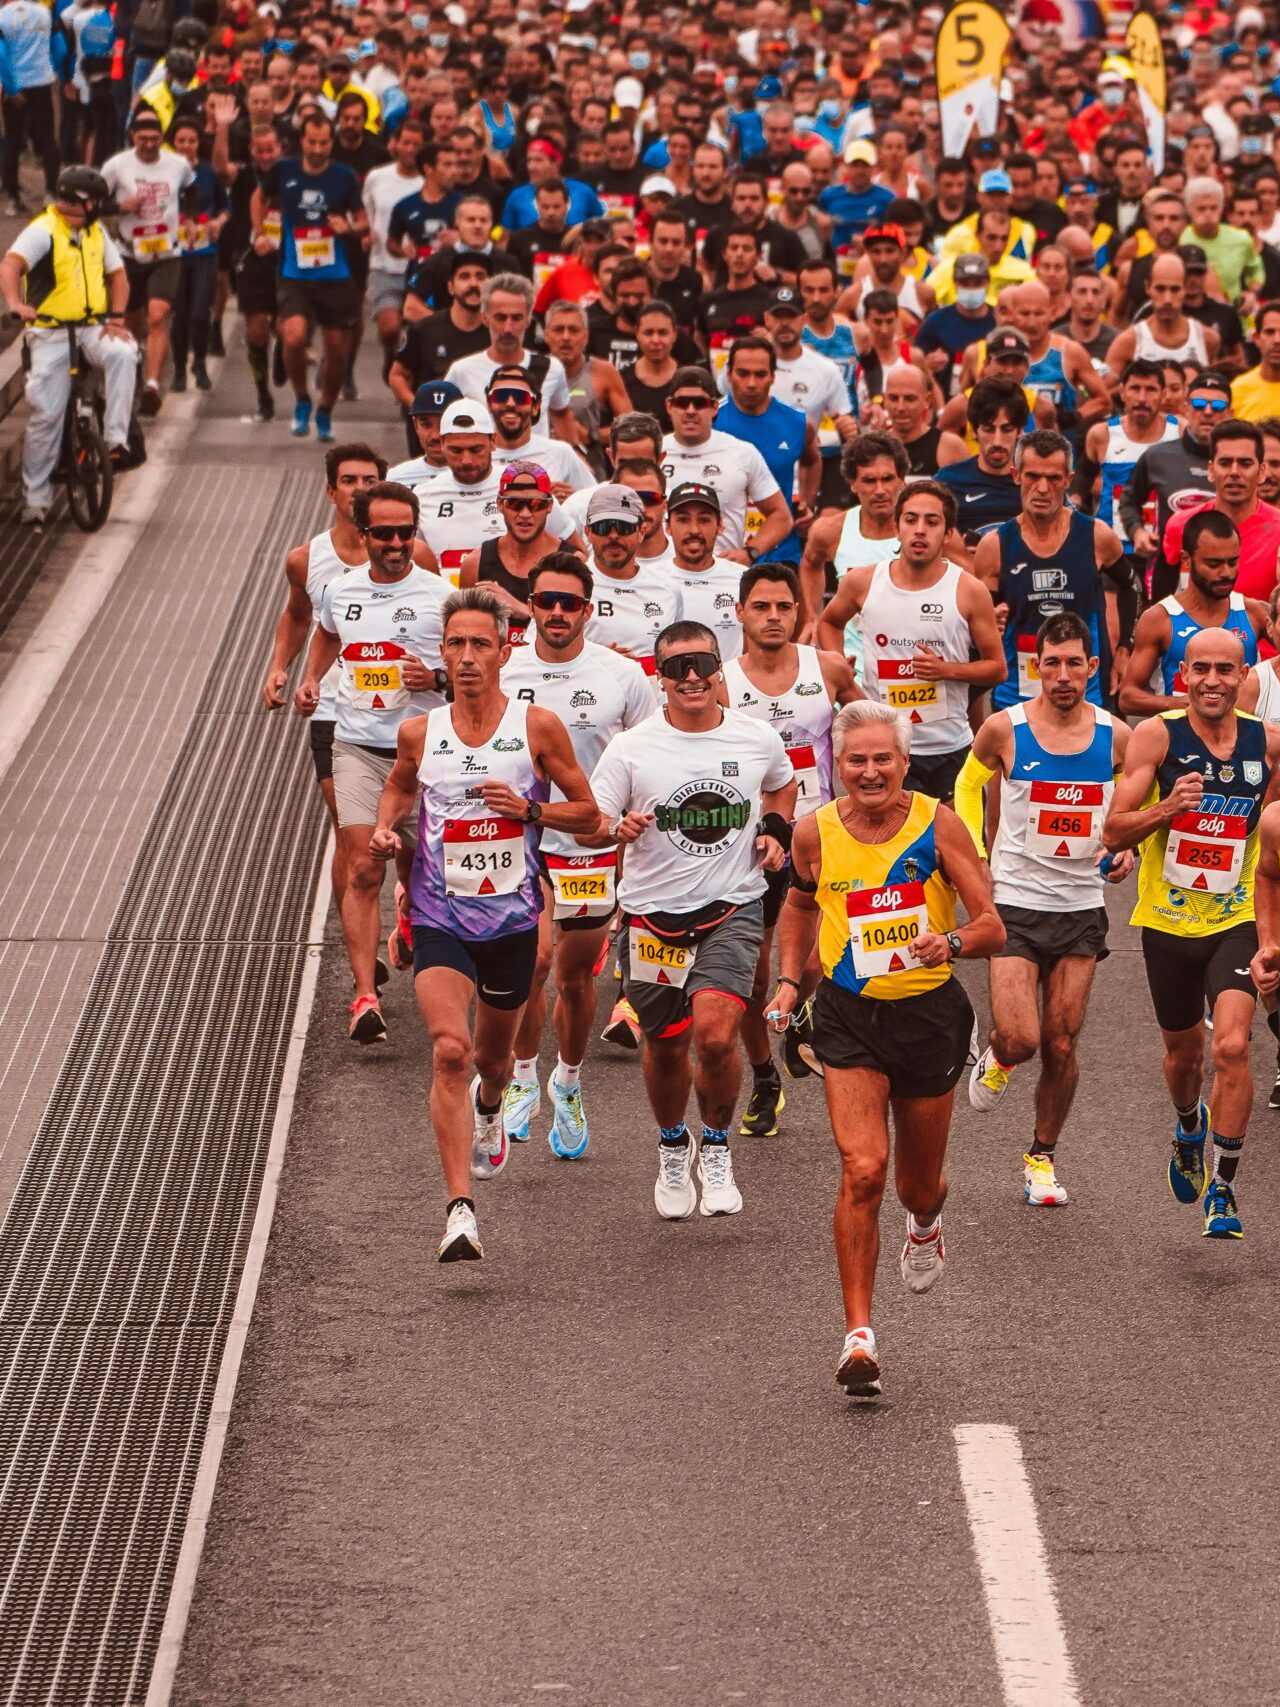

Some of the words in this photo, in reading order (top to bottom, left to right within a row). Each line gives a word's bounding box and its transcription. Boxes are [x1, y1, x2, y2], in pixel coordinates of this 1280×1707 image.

[955, 14, 984, 66] 5
[433, 393, 446, 405] U
[361, 644, 385, 660] edp
[363, 673, 389, 686] 209
[738, 699, 758, 708] VIATOR
[889, 687, 937, 704] 10422
[672, 781, 736, 804] DIRECTIVO
[1055, 785, 1083, 805] edp
[468, 820, 499, 841] edp
[1050, 818, 1083, 834] 456
[1196, 817, 1225, 837] edp
[680, 838, 730, 855] ULTRAS
[460, 851, 512, 871] 4318
[1189, 848, 1222, 866] 255
[561, 880, 606, 897] 10421
[871, 888, 903, 911] edp
[863, 922, 919, 947] 10400
[638, 942, 686, 965] 10416
